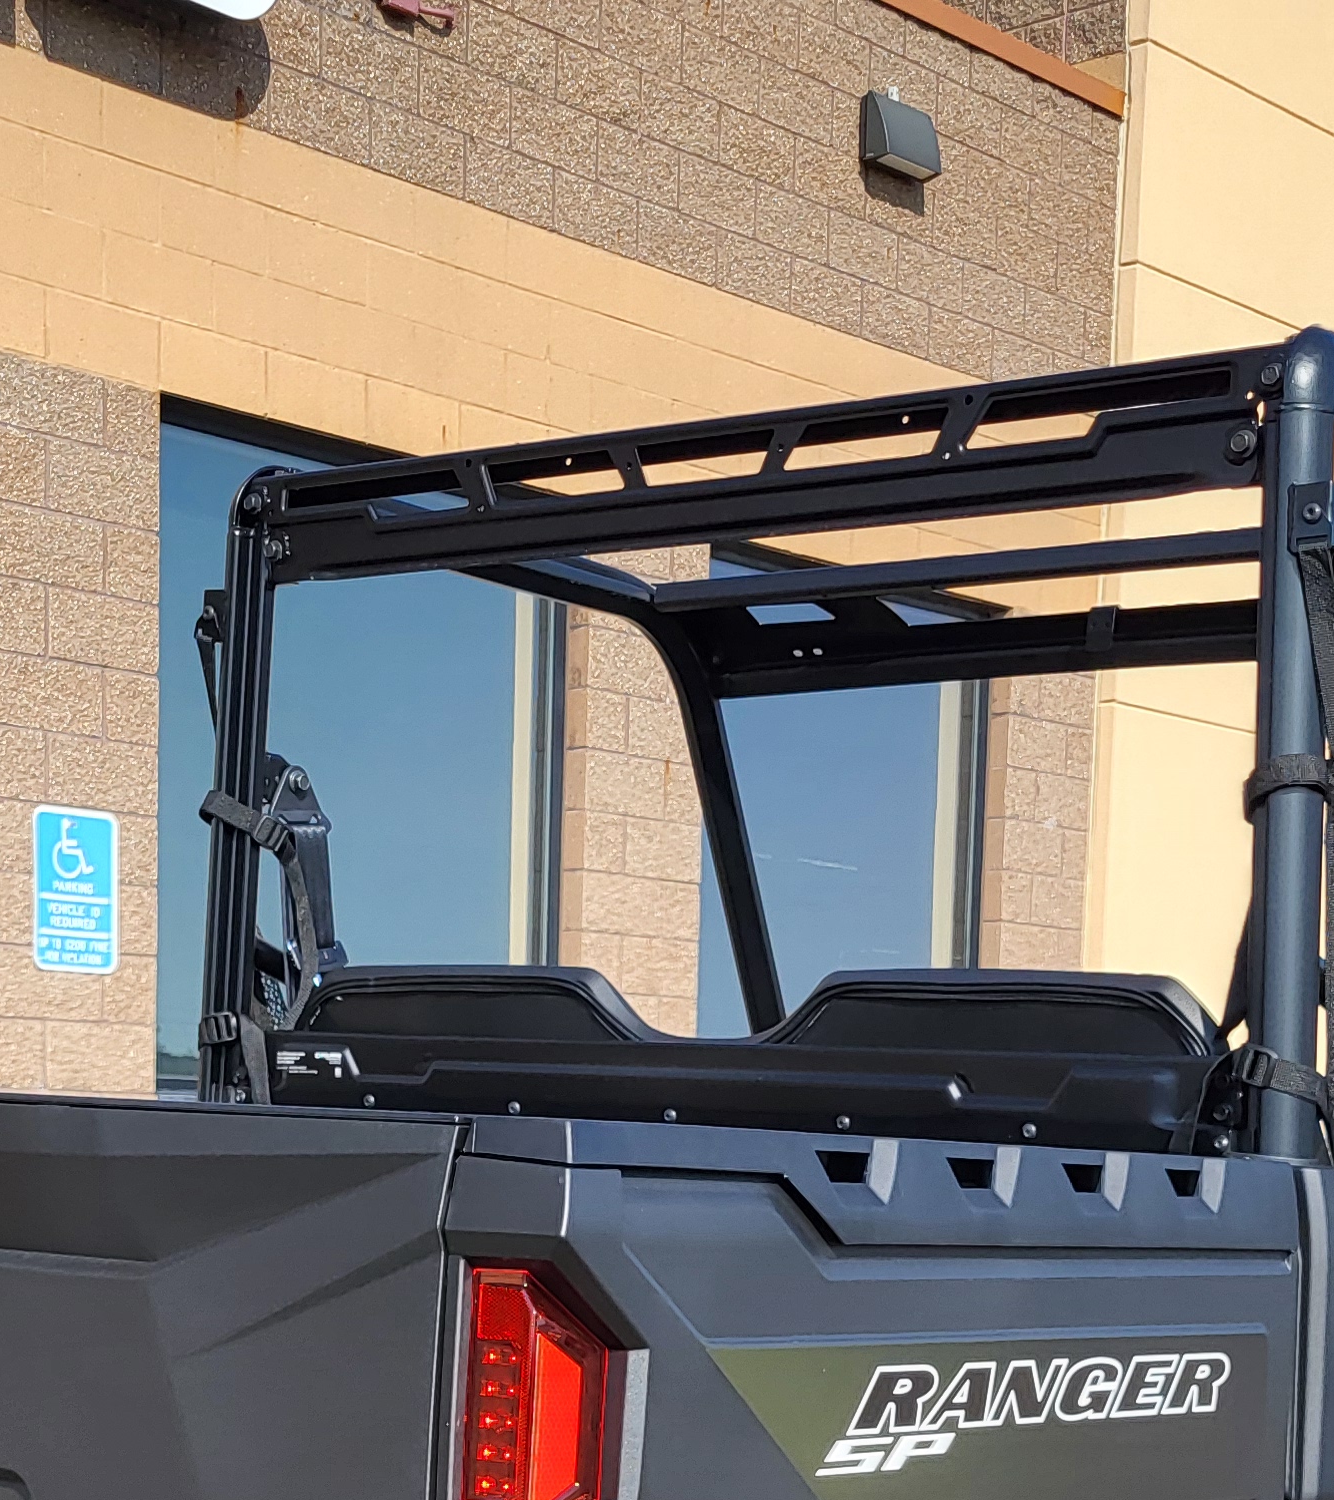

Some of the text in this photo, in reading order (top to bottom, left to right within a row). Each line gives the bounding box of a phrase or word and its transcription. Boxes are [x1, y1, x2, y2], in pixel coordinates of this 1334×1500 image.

[52, 880, 94, 895] PARKING
[47, 902, 86, 917] VEHICLE
[49, 915, 97, 931] REQUIRED
[845, 1351, 1232, 1438] RANGER
[814, 1432, 957, 1478] SP
